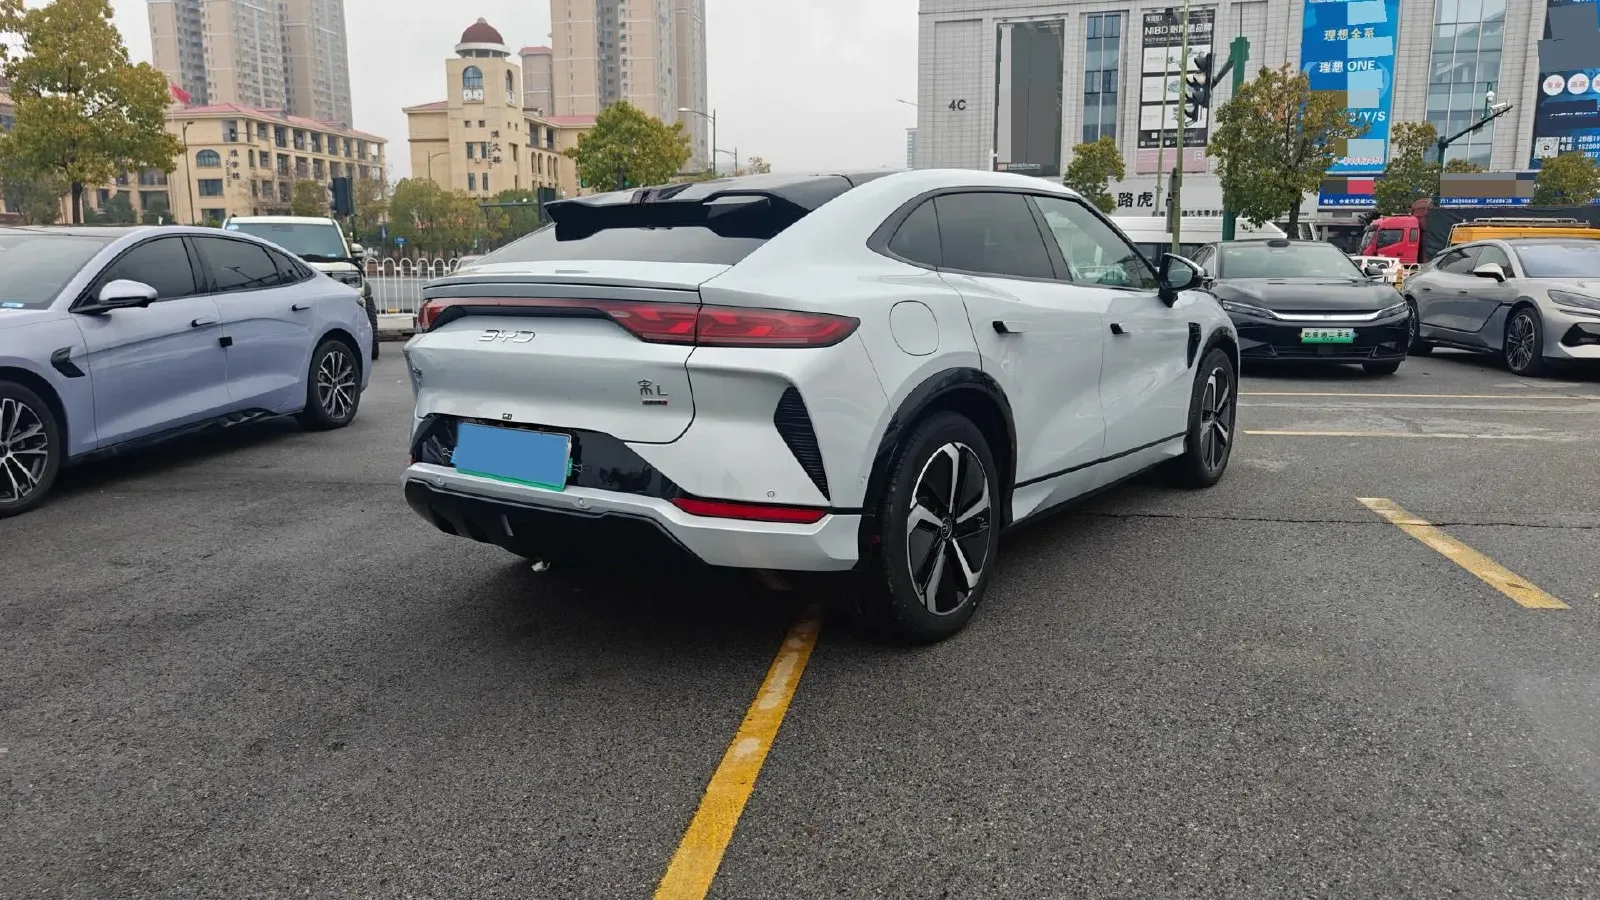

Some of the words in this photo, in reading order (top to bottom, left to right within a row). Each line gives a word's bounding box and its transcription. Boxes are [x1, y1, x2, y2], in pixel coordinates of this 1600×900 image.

[1144, 25, 1169, 35] NIBD
[1323, 27, 1375, 41] 理想全系
[1319, 61, 1344, 73] 理想
[1347, 60, 1376, 71] ONE
[949, 99, 967, 111] 4C
[1117, 192, 1153, 208] 路虎
[478, 329, 536, 343] BYD
